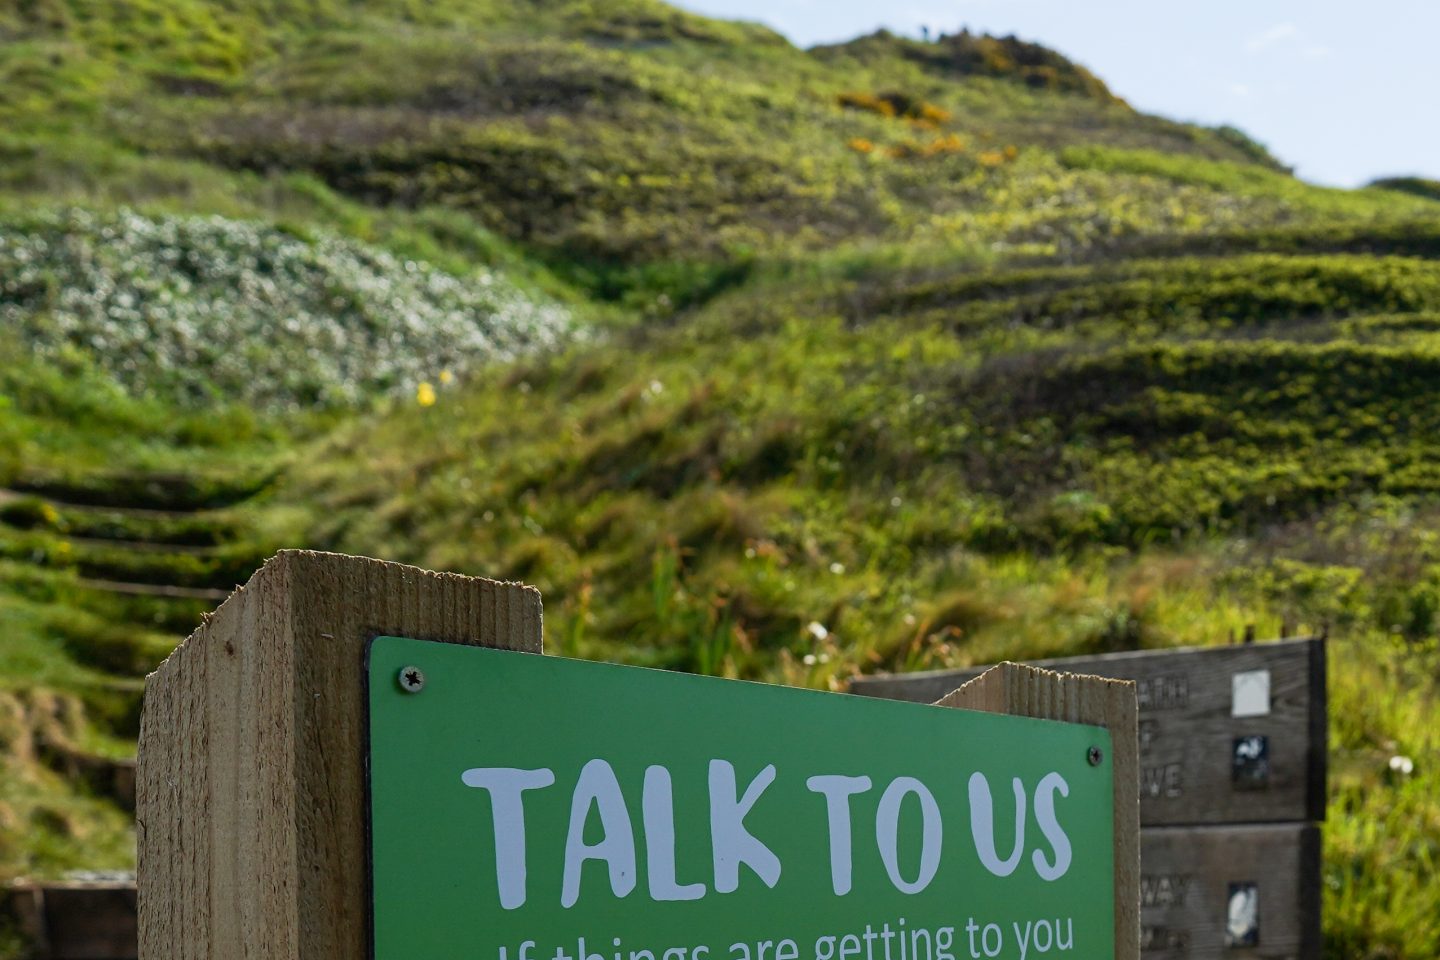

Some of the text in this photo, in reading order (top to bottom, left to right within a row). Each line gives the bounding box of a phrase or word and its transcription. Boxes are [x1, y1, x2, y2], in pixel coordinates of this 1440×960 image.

[461, 758, 1073, 910] TALK TO US
[965, 916, 1003, 960] to
